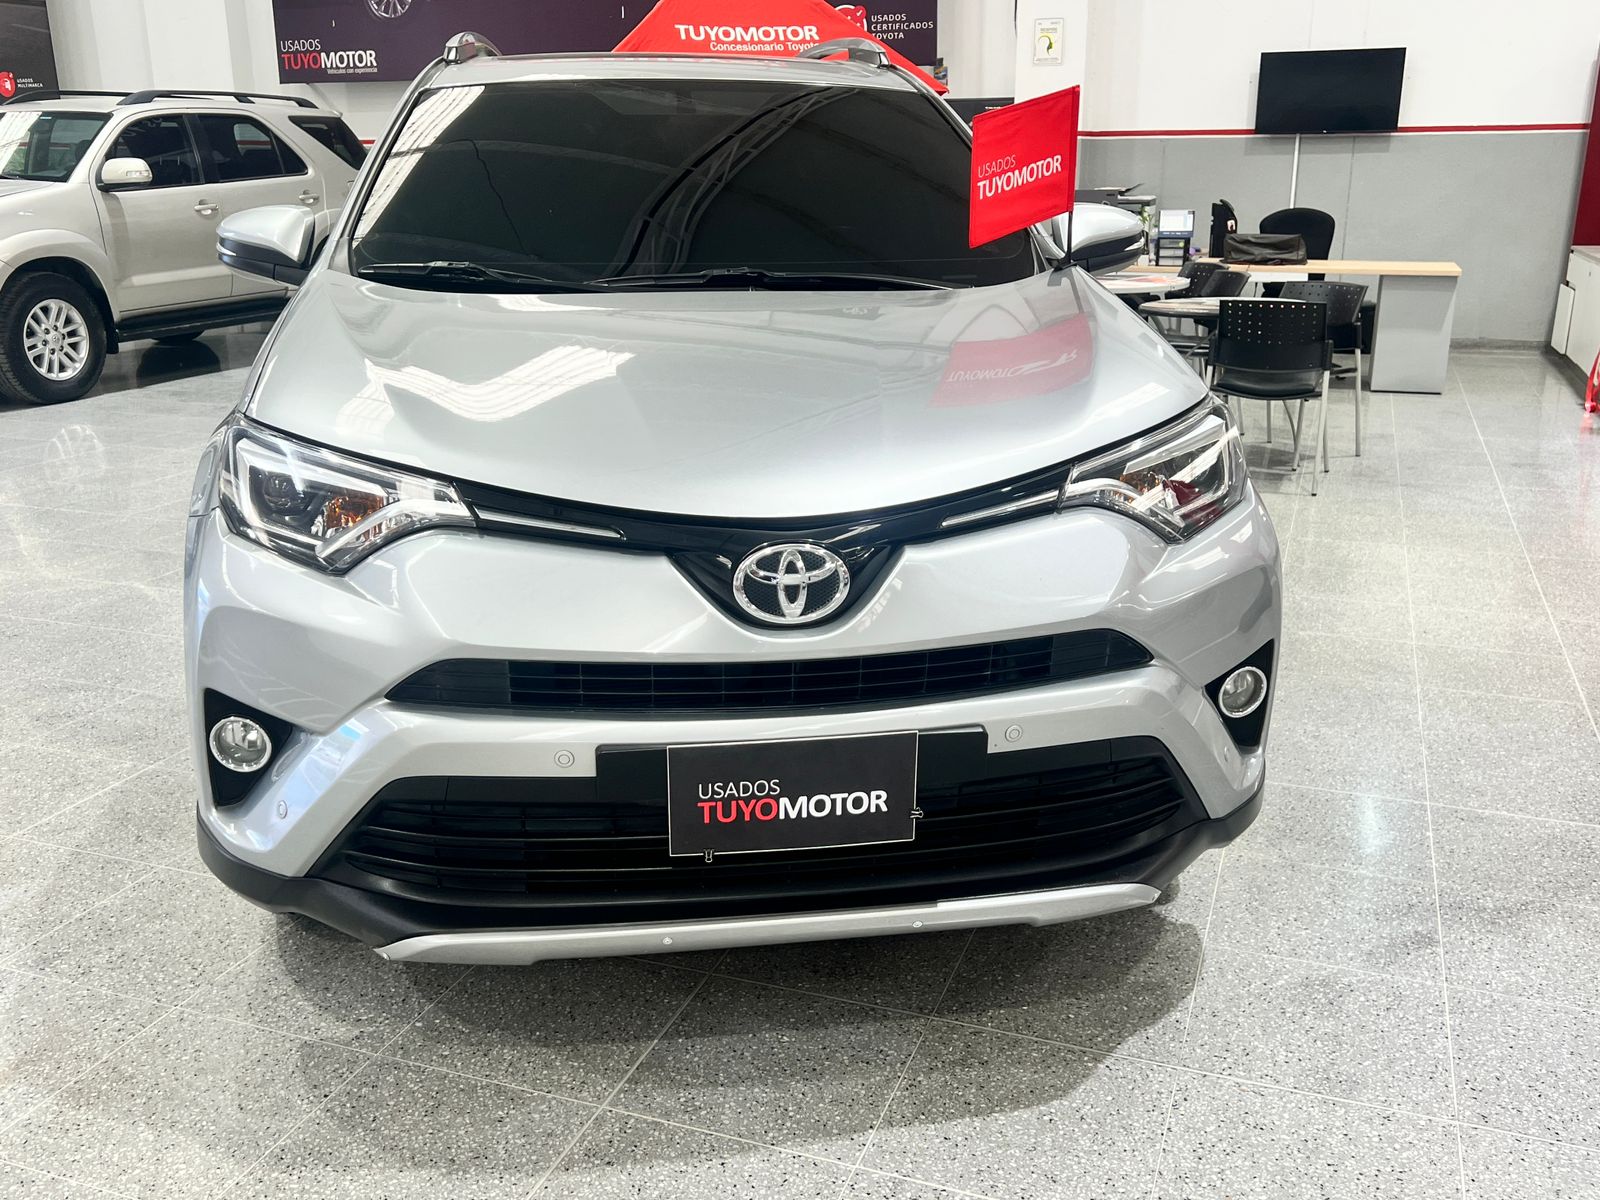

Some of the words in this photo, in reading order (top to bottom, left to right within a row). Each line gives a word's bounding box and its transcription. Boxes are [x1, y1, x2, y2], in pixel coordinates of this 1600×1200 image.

[871, 14, 907, 22] USADOS
[871, 21, 934, 31] CERTIFICADOS
[674, 24, 820, 42] TUYOMOTOR
[280, 39, 321, 52] USADOS
[710, 41, 784, 51] Concesionario
[281, 50, 377, 70] TUYOMOTOR
[978, 154, 1016, 178] USADOS
[977, 154, 1062, 200] TUYOMOTOR
[698, 779, 781, 799] USADOS
[697, 789, 889, 824] TUYOMOTOR
